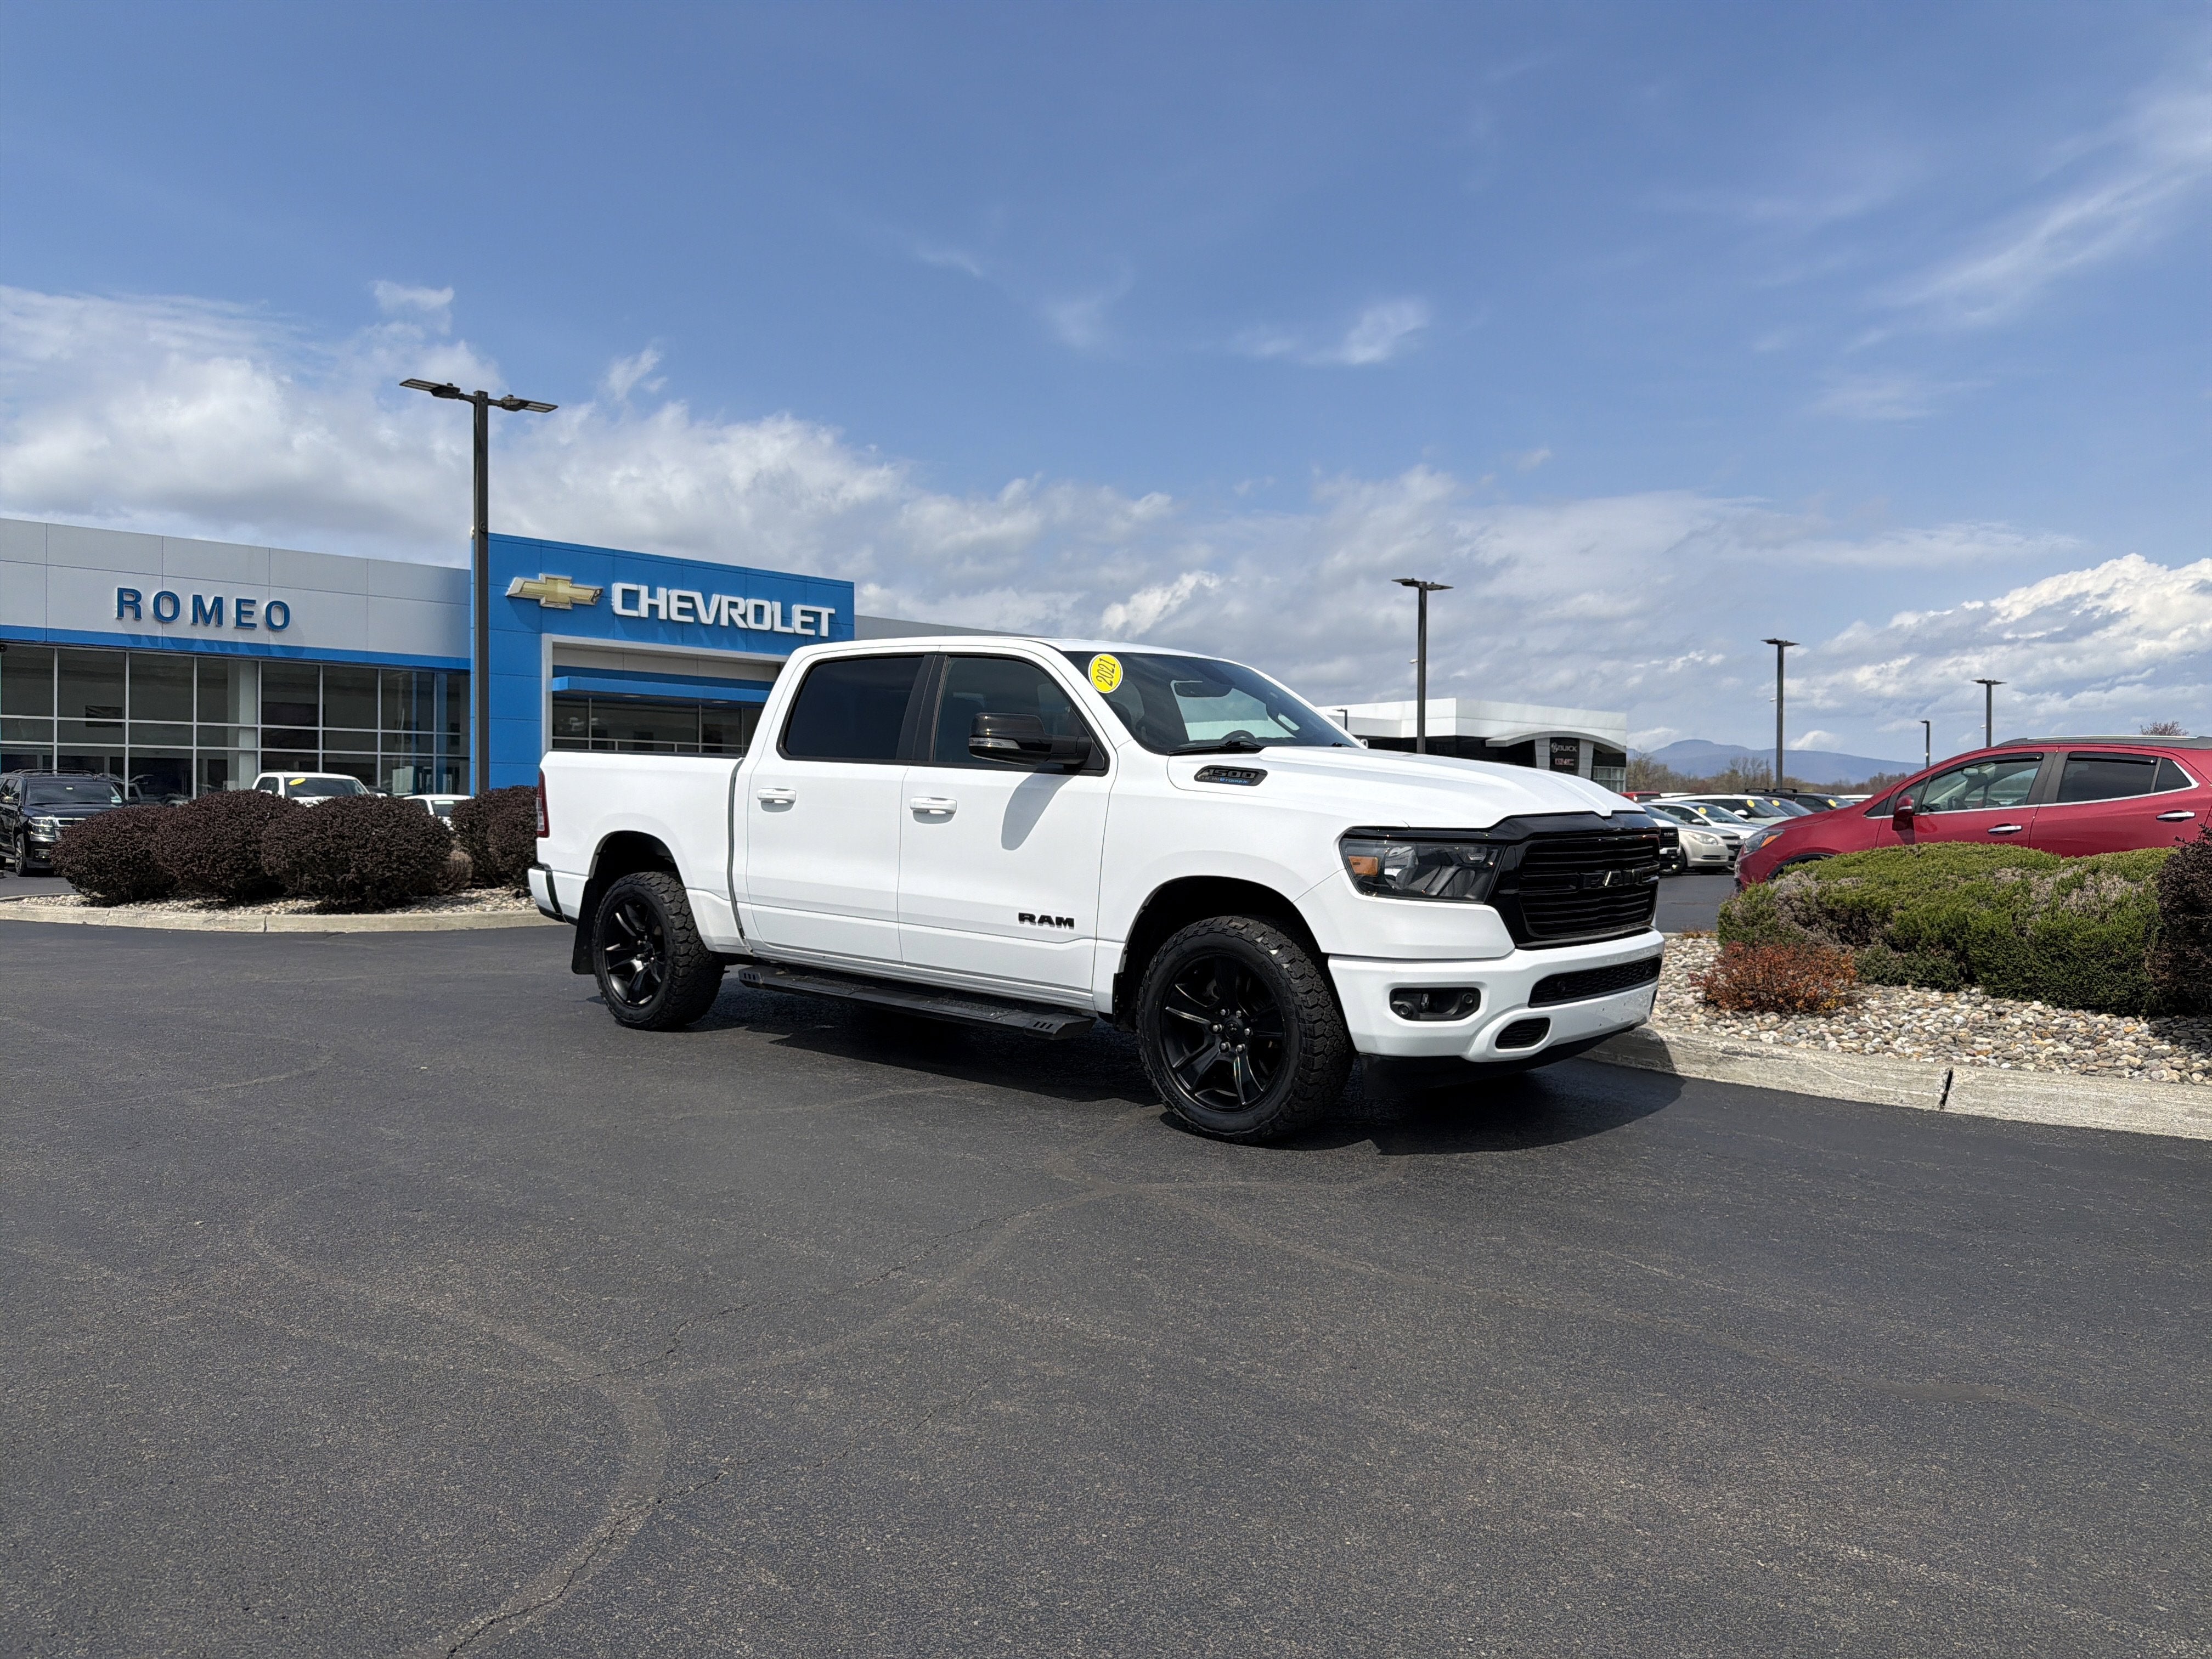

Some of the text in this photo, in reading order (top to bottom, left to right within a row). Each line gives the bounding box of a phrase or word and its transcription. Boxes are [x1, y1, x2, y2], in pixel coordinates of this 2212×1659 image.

[117, 587, 290, 630] ROMEO
[612, 583, 835, 637] CHEVROLET
[1096, 658, 1115, 687] 2021
[1205, 769, 1255, 779] 1500
[1581, 868, 1643, 889] RAM
[1018, 912, 1075, 929] RAM
